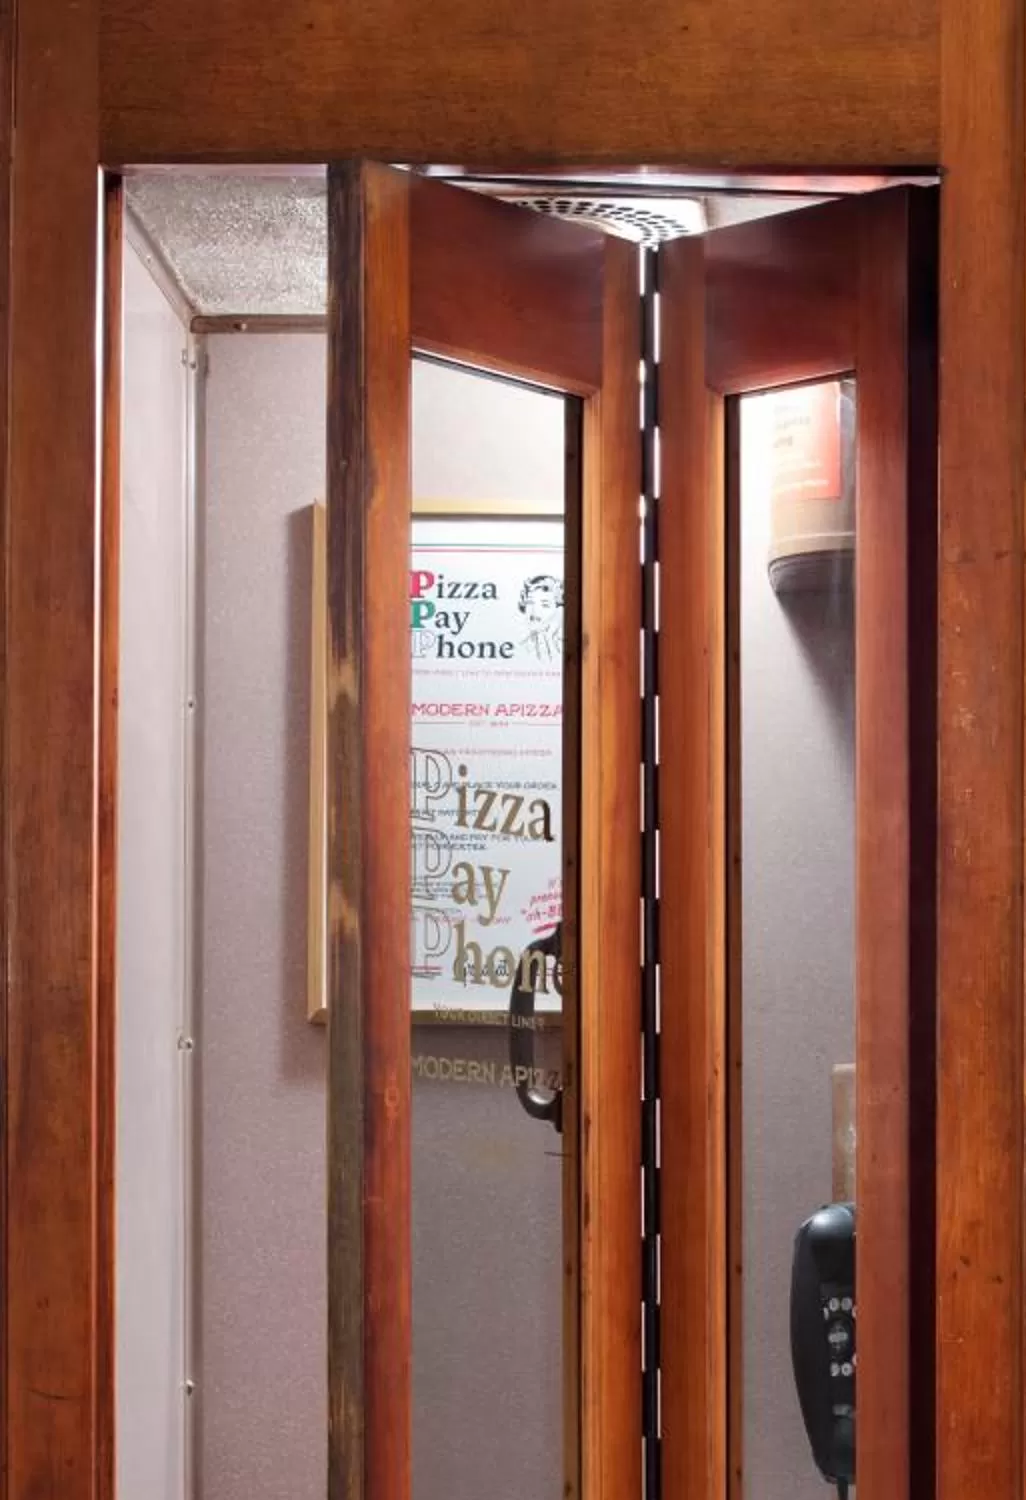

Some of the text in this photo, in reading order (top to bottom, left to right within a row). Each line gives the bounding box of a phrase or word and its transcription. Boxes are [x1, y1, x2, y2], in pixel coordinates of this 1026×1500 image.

[410, 571, 498, 600] Pizza
[410, 601, 471, 635] Pay
[411, 630, 515, 659] Phone
[411, 703, 490, 718] MODERN
[410, 747, 555, 842] Pizza
[411, 826, 512, 927] Pay
